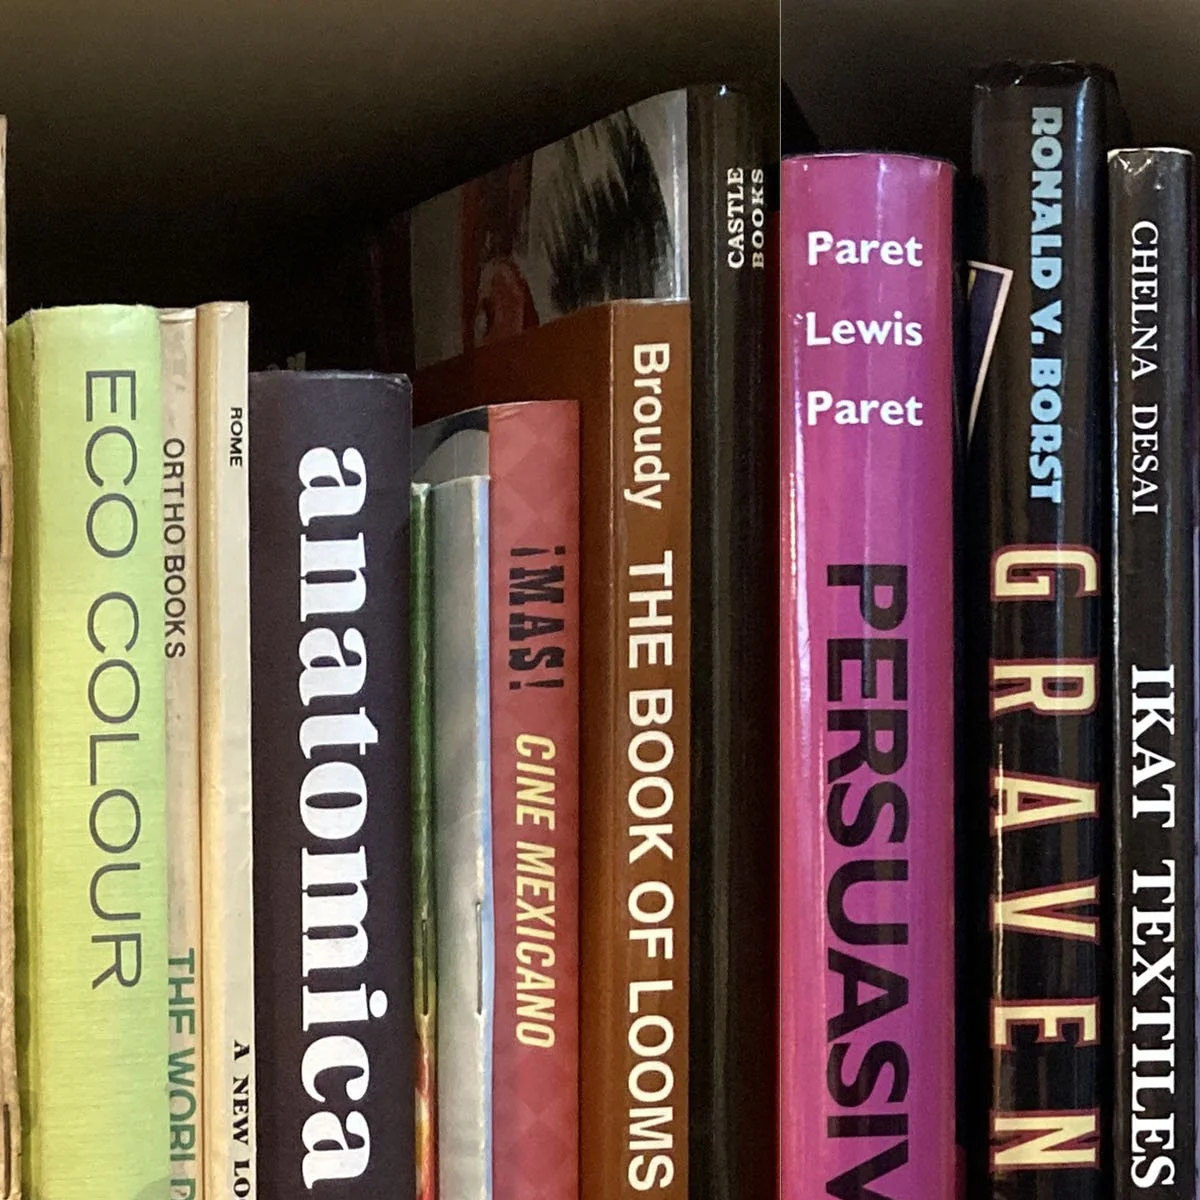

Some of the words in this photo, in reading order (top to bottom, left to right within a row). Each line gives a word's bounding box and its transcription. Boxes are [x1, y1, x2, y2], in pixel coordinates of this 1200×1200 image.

[727, 168, 743, 269] CASTLE
[752, 168, 763, 270] BOOKS
[808, 230, 923, 267] Paret
[1031, 107, 1063, 289] RONALD
[806, 311, 923, 347] Lewis
[1131, 220, 1159, 380] CHELNA
[86, 369, 138, 559] ECO
[230, 407, 243, 466] ROME
[624, 343, 670, 510] Broudy
[807, 390, 923, 427] Paret
[1030, 358, 1063, 504] BORST
[1131, 405, 1159, 515] DESAI
[163, 437, 185, 551] ORTHO
[164, 555, 186, 659] BOOKS
[509, 545, 565, 690] ¡MAS!
[628, 550, 672, 669] THE
[87, 591, 142, 991] COLOUR
[298, 446, 388, 1190] anatomica
[516, 734, 555, 831] CINE
[628, 689, 673, 863] BOOK
[1132, 665, 1176, 828] IKAT
[628, 881, 673, 960] OF
[990, 543, 1100, 1170] GRAVEN
[516, 840, 556, 1049] MEXICANO
[628, 981, 674, 1191] LOOMS
[1131, 860, 1176, 1188] TEXTILES
[233, 1076, 249, 1145] NEW
